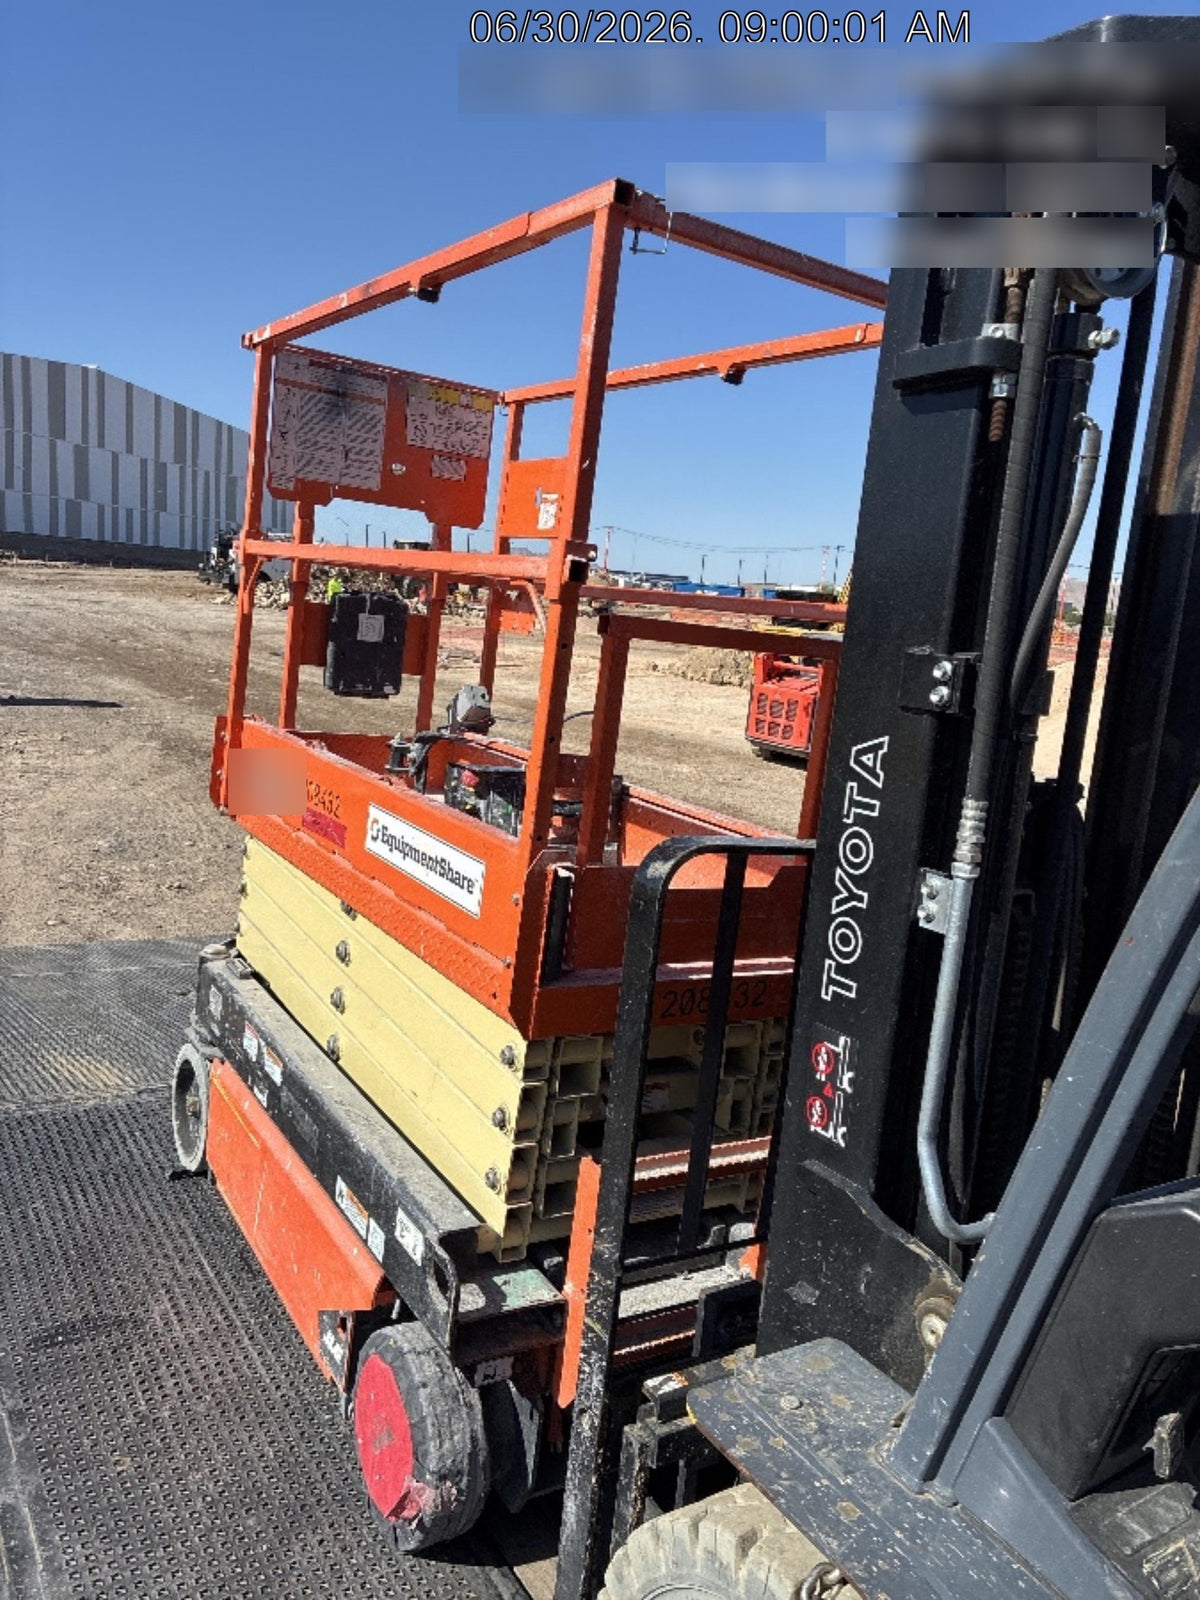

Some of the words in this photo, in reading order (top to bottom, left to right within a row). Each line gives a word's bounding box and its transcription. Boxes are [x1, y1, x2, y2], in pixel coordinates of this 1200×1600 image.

[380, 824, 475, 895] EquipmentShare
[821, 735, 890, 1001] TOYOTA
[661, 979, 769, 1018] 20832
